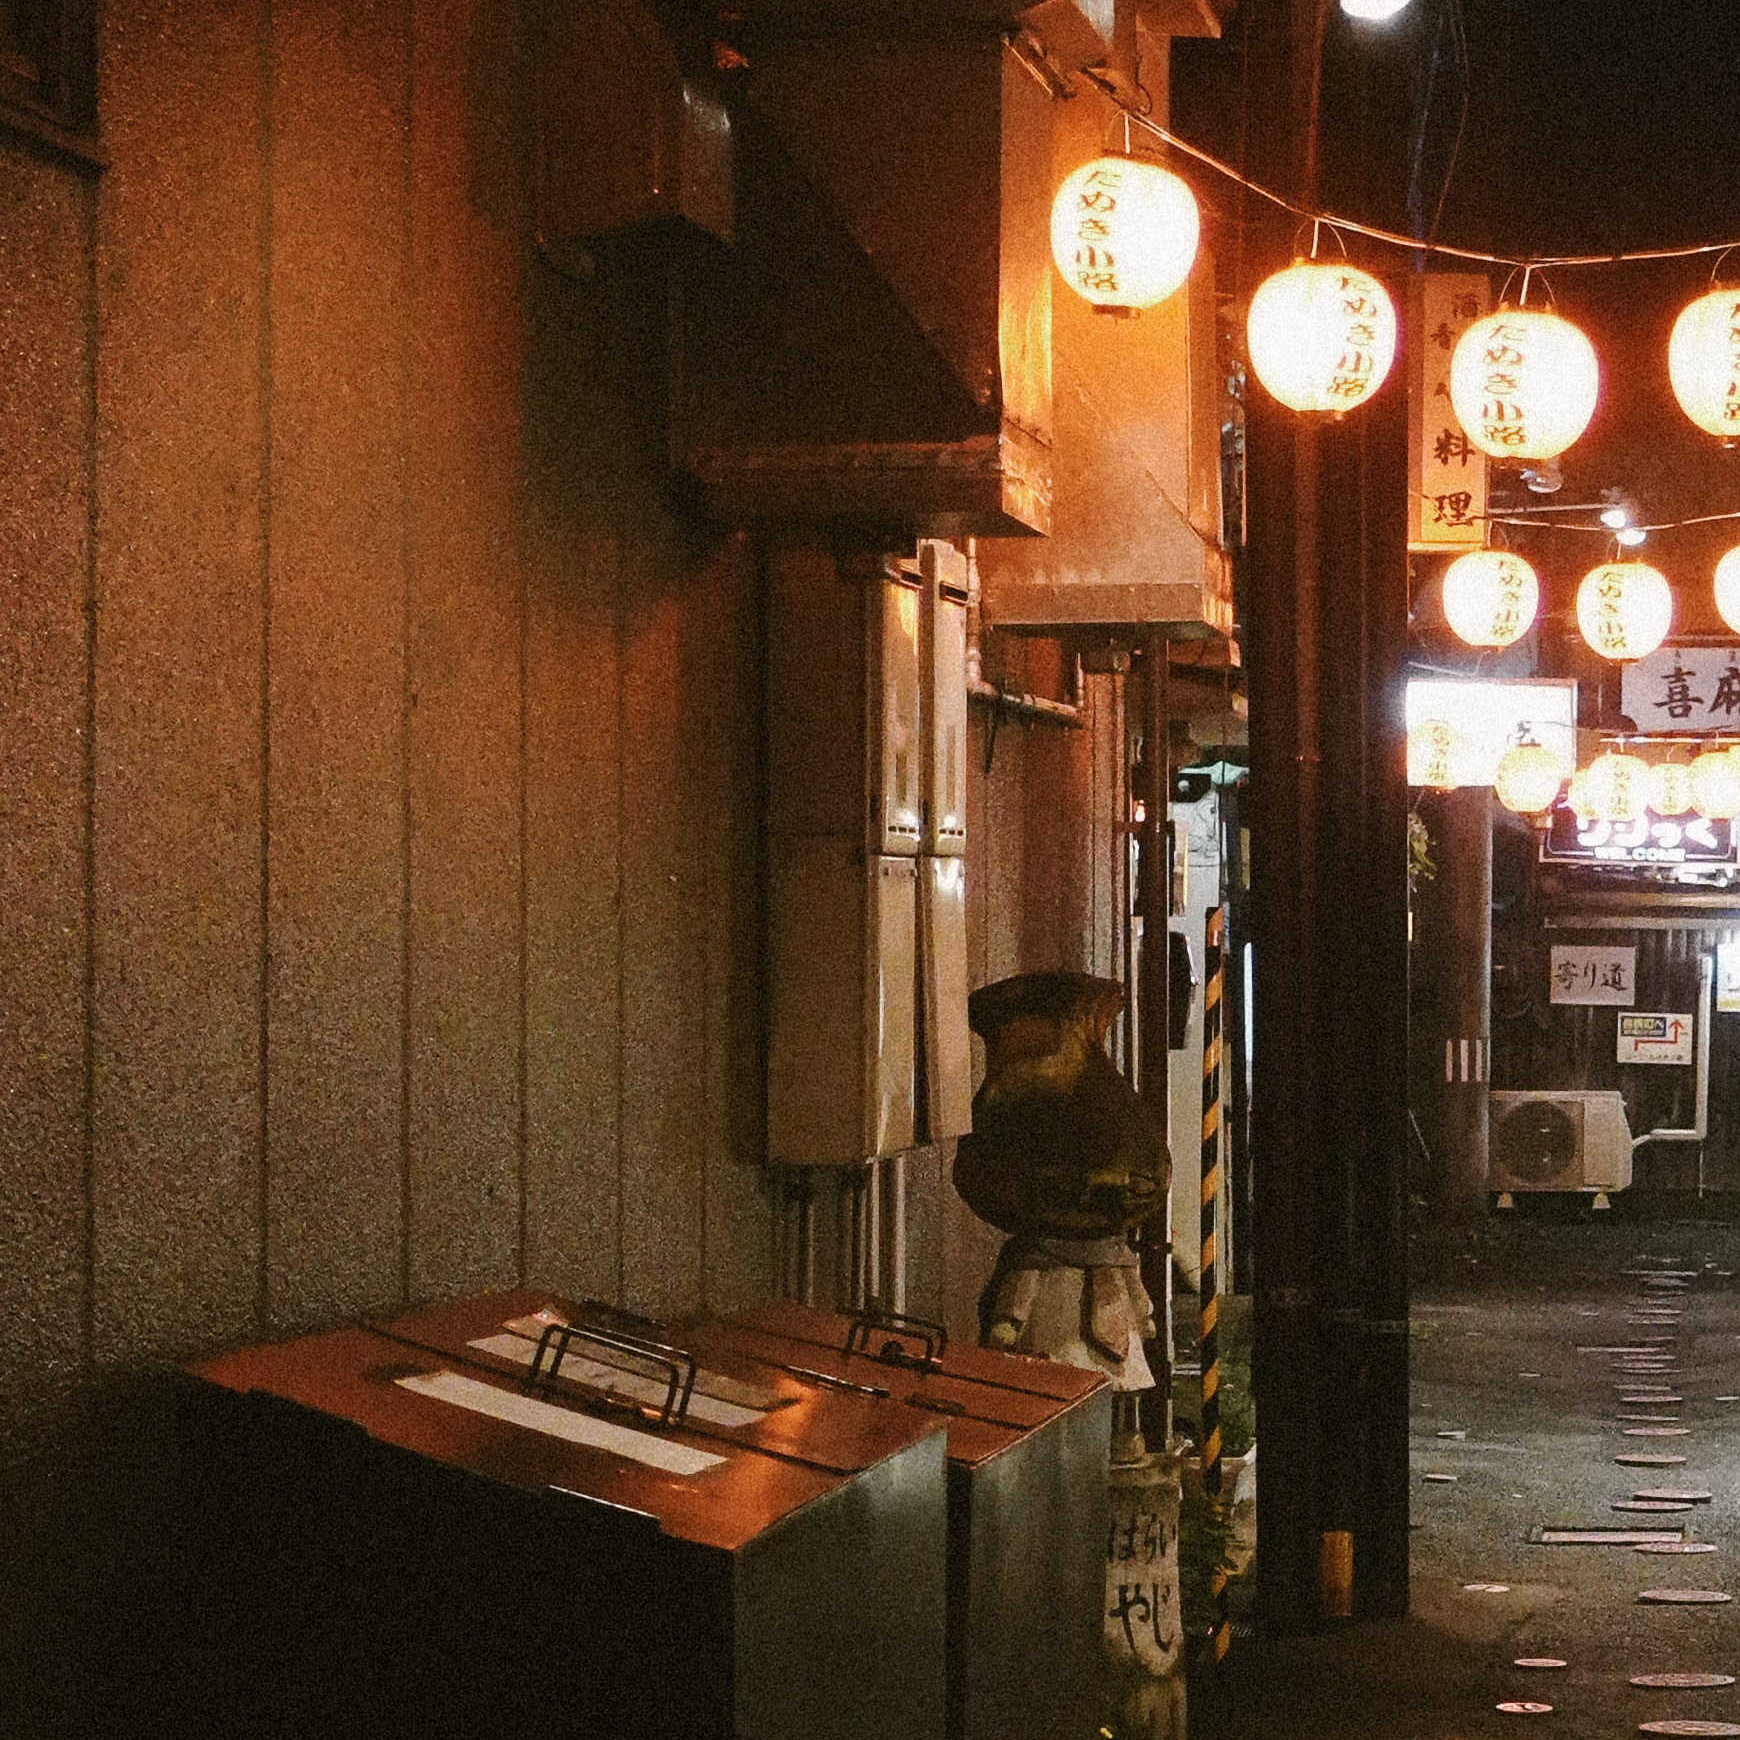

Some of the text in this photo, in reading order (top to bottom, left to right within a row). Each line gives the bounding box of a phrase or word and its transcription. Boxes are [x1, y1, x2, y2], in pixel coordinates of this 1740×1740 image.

[1075, 171, 1118, 292] たぬき小路
[1327, 277, 1378, 398] たぬき小路
[1483, 324, 1527, 446] たぬき小路
[1594, 847, 1686, 862] WELCOME
[1554, 959, 1629, 992] 寄り道
